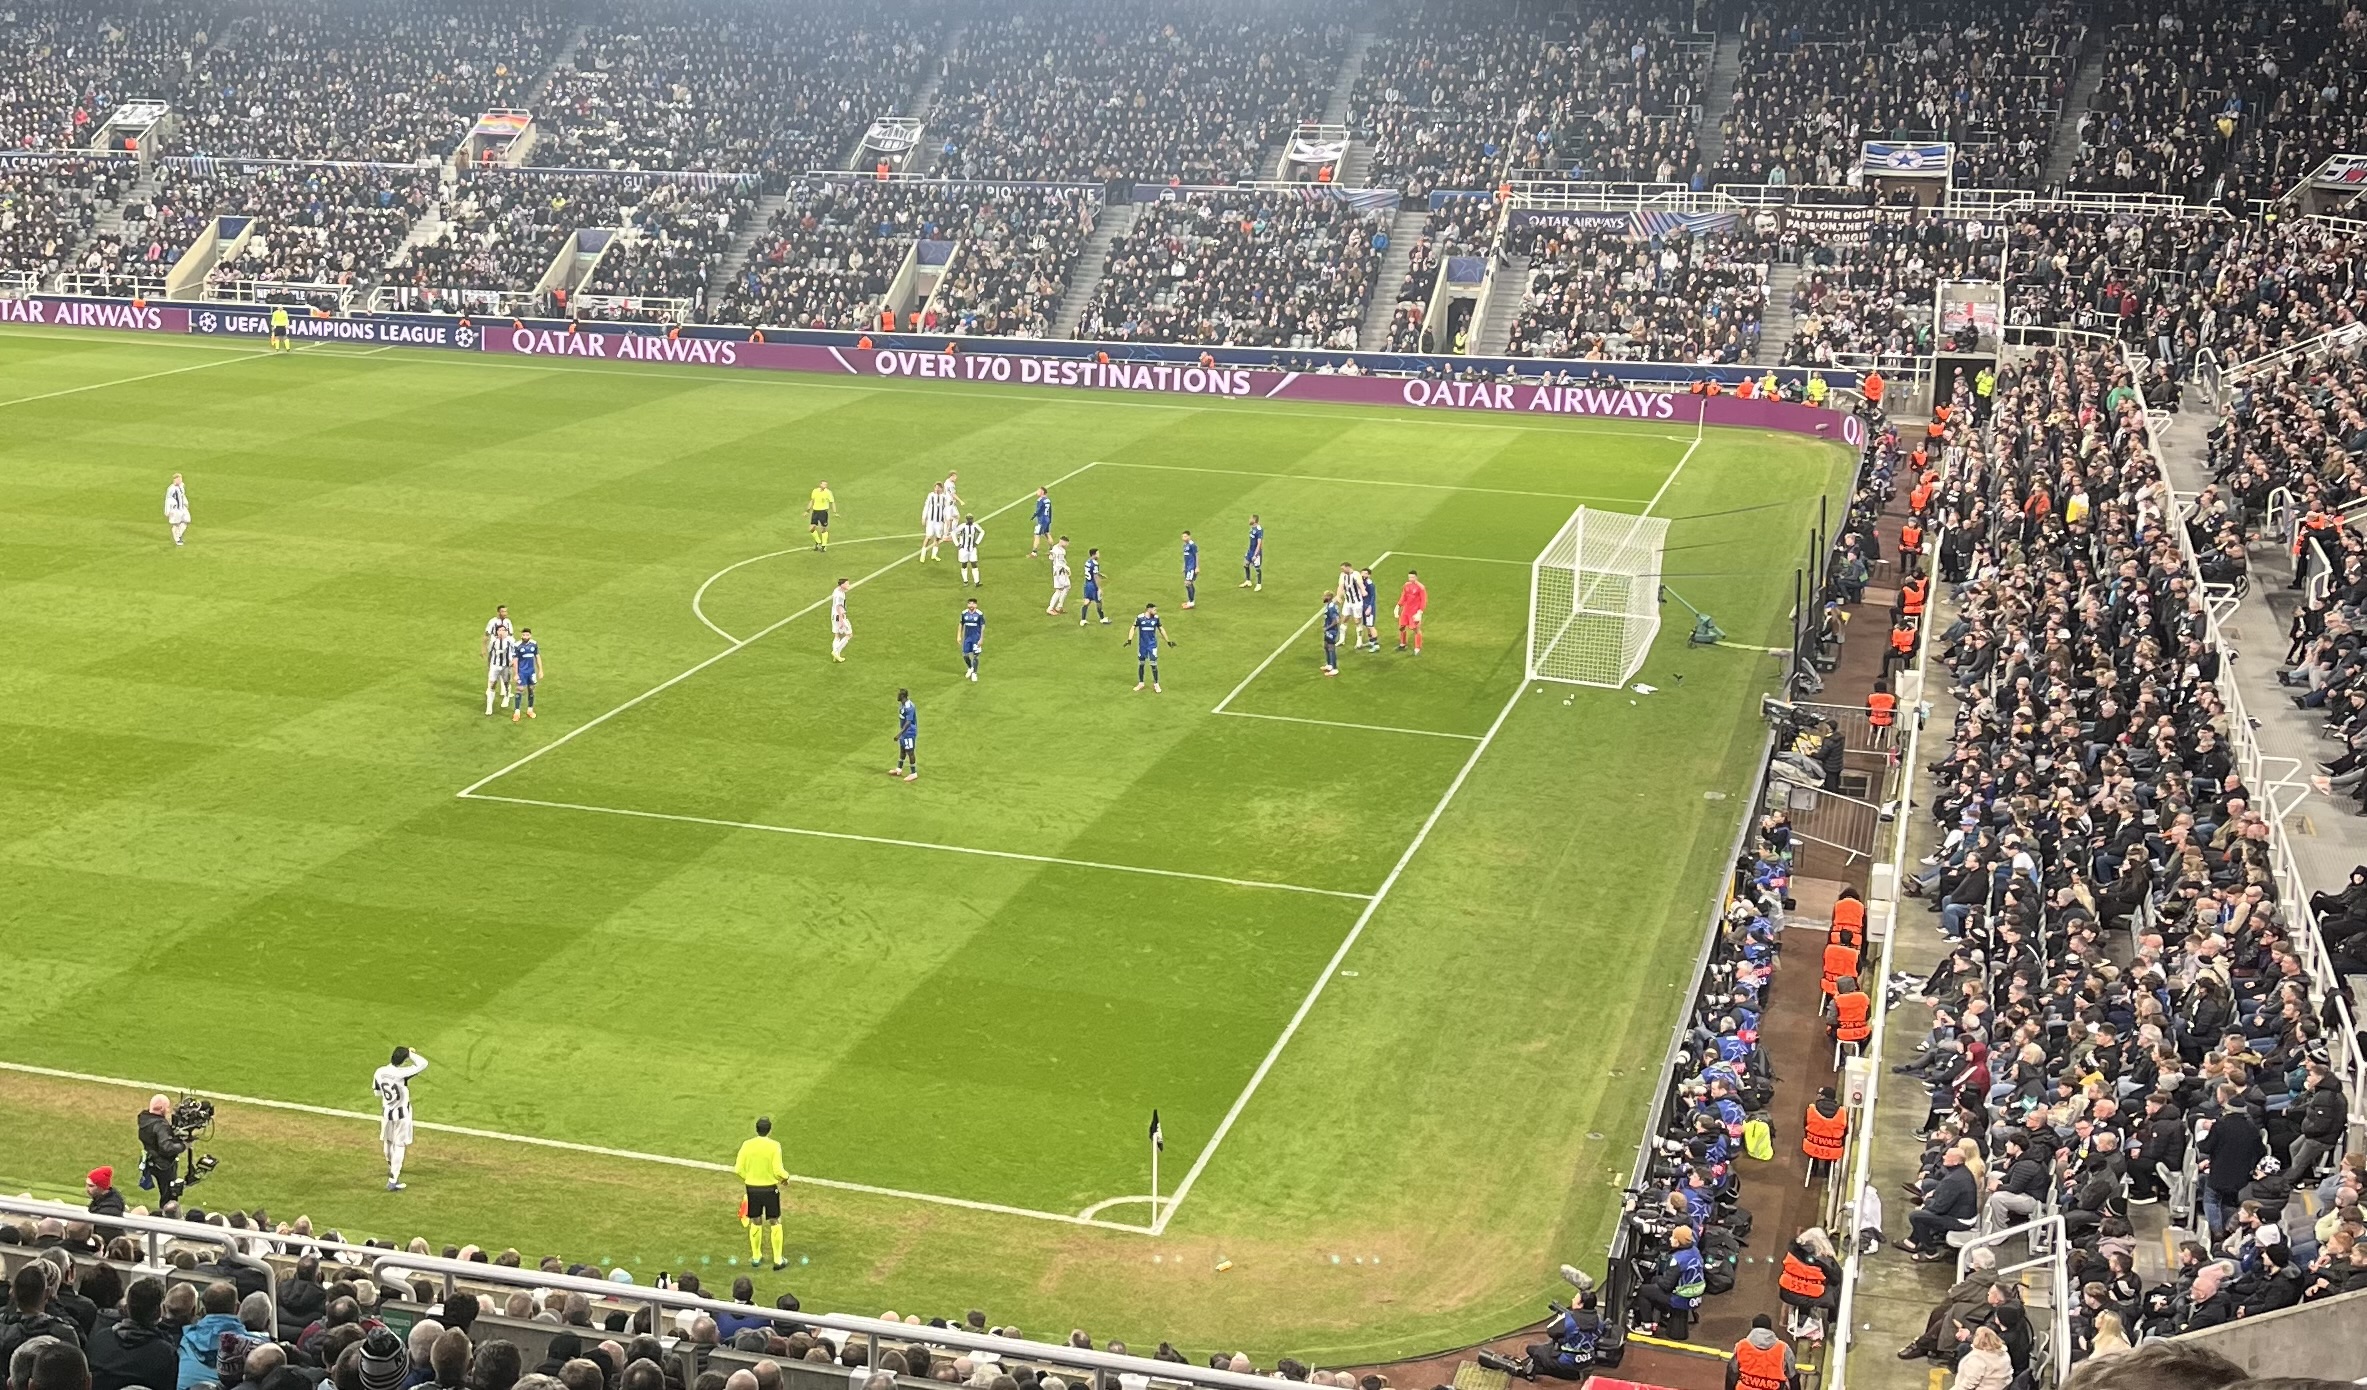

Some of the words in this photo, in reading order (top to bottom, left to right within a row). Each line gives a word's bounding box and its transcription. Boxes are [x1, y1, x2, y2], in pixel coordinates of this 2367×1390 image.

[1528, 215, 1570, 227] QATAR
[1573, 216, 1625, 229] AIRWAYS
[1816, 211, 1841, 219] THE
[54, 302, 162, 330] AIRWAYS
[225, 315, 269, 333] UEFA
[286, 317, 375, 340] HAMPIONS
[380, 324, 447, 344] LEAGUE
[512, 329, 605, 357] QATAR
[616, 335, 736, 365] AIRWAYS
[875, 350, 957, 379] OVER
[965, 355, 1011, 382] 170
[1019, 358, 1251, 395] DESTINATIONS
[1403, 380, 1515, 409] QATAR
[1529, 386, 1674, 418] AIRWAYS
[380, 1082, 401, 1101] 61
